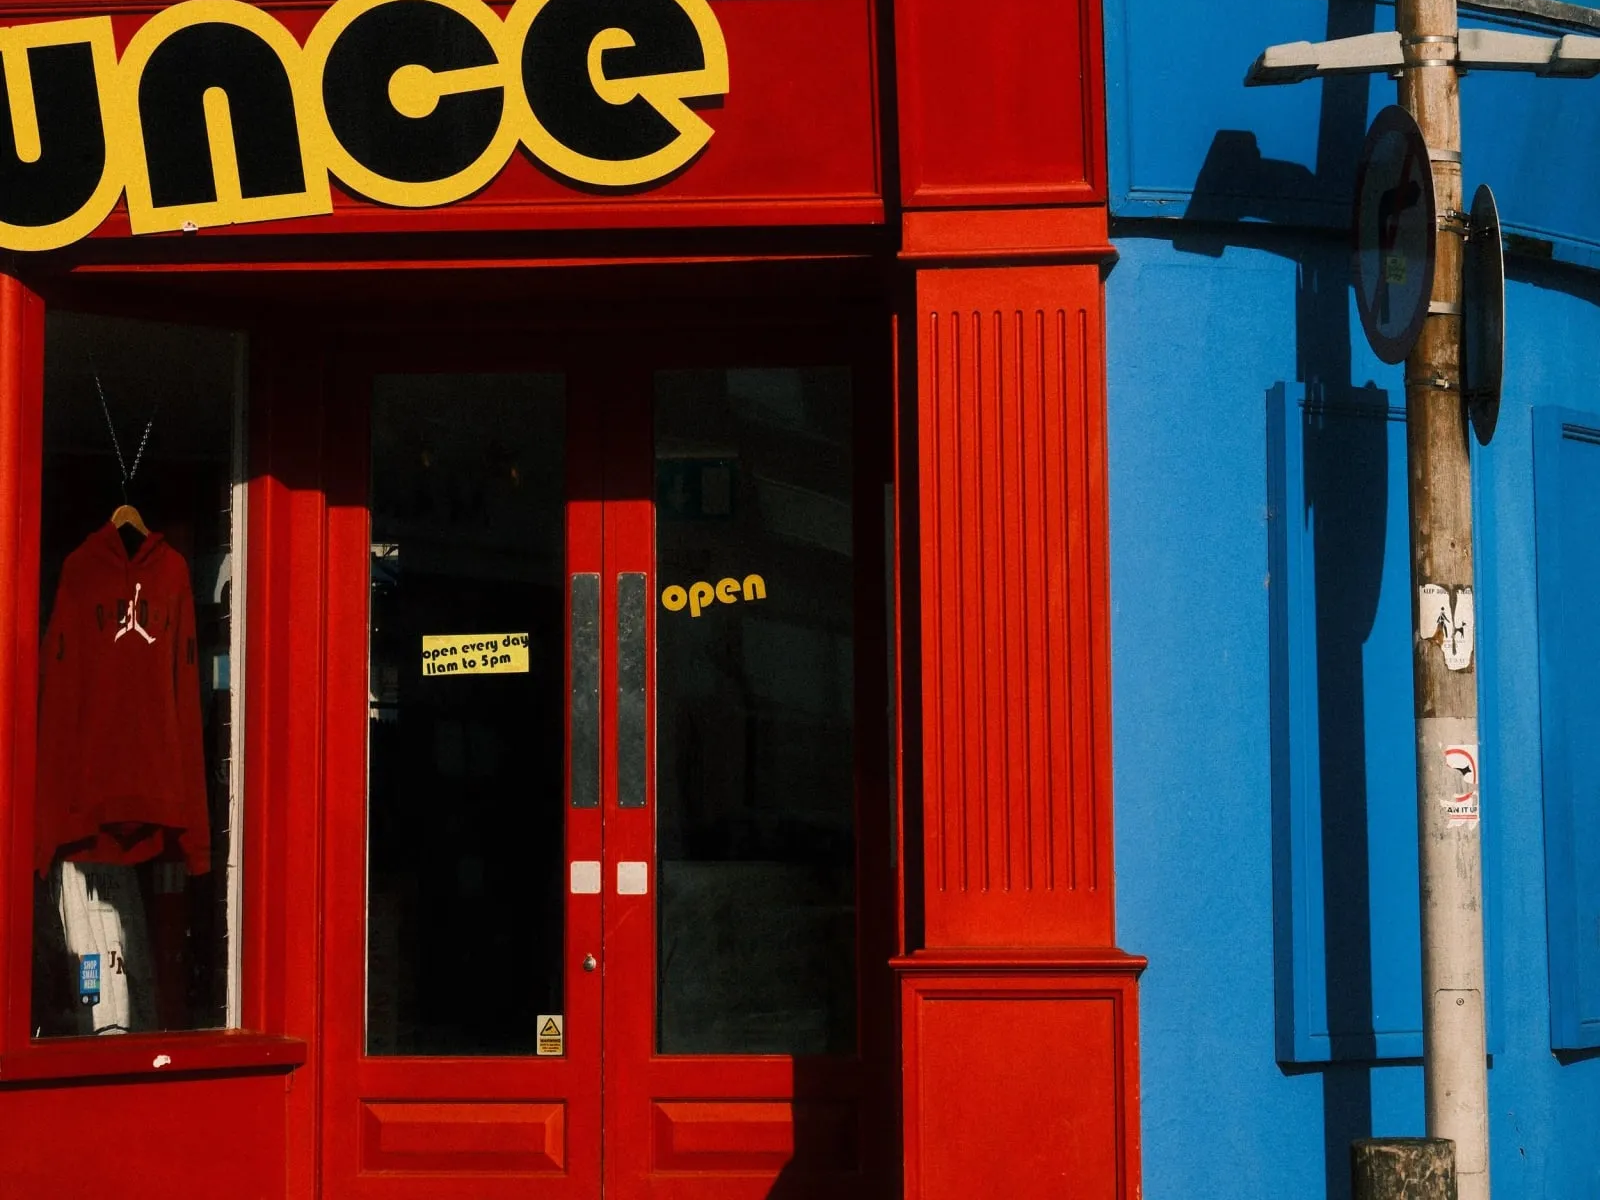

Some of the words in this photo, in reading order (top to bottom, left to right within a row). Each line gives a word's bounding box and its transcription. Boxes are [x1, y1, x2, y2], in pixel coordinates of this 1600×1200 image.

[661, 573, 767, 617] open
[422, 646, 458, 660] open
[461, 640, 498, 653] every
[502, 635, 529, 648] day
[461, 658, 477, 668] to
[481, 654, 511, 668] 5pm
[83, 960, 97, 969] SHOP
[82, 970, 98, 979] SMALL
[83, 979, 97, 989] HERE
